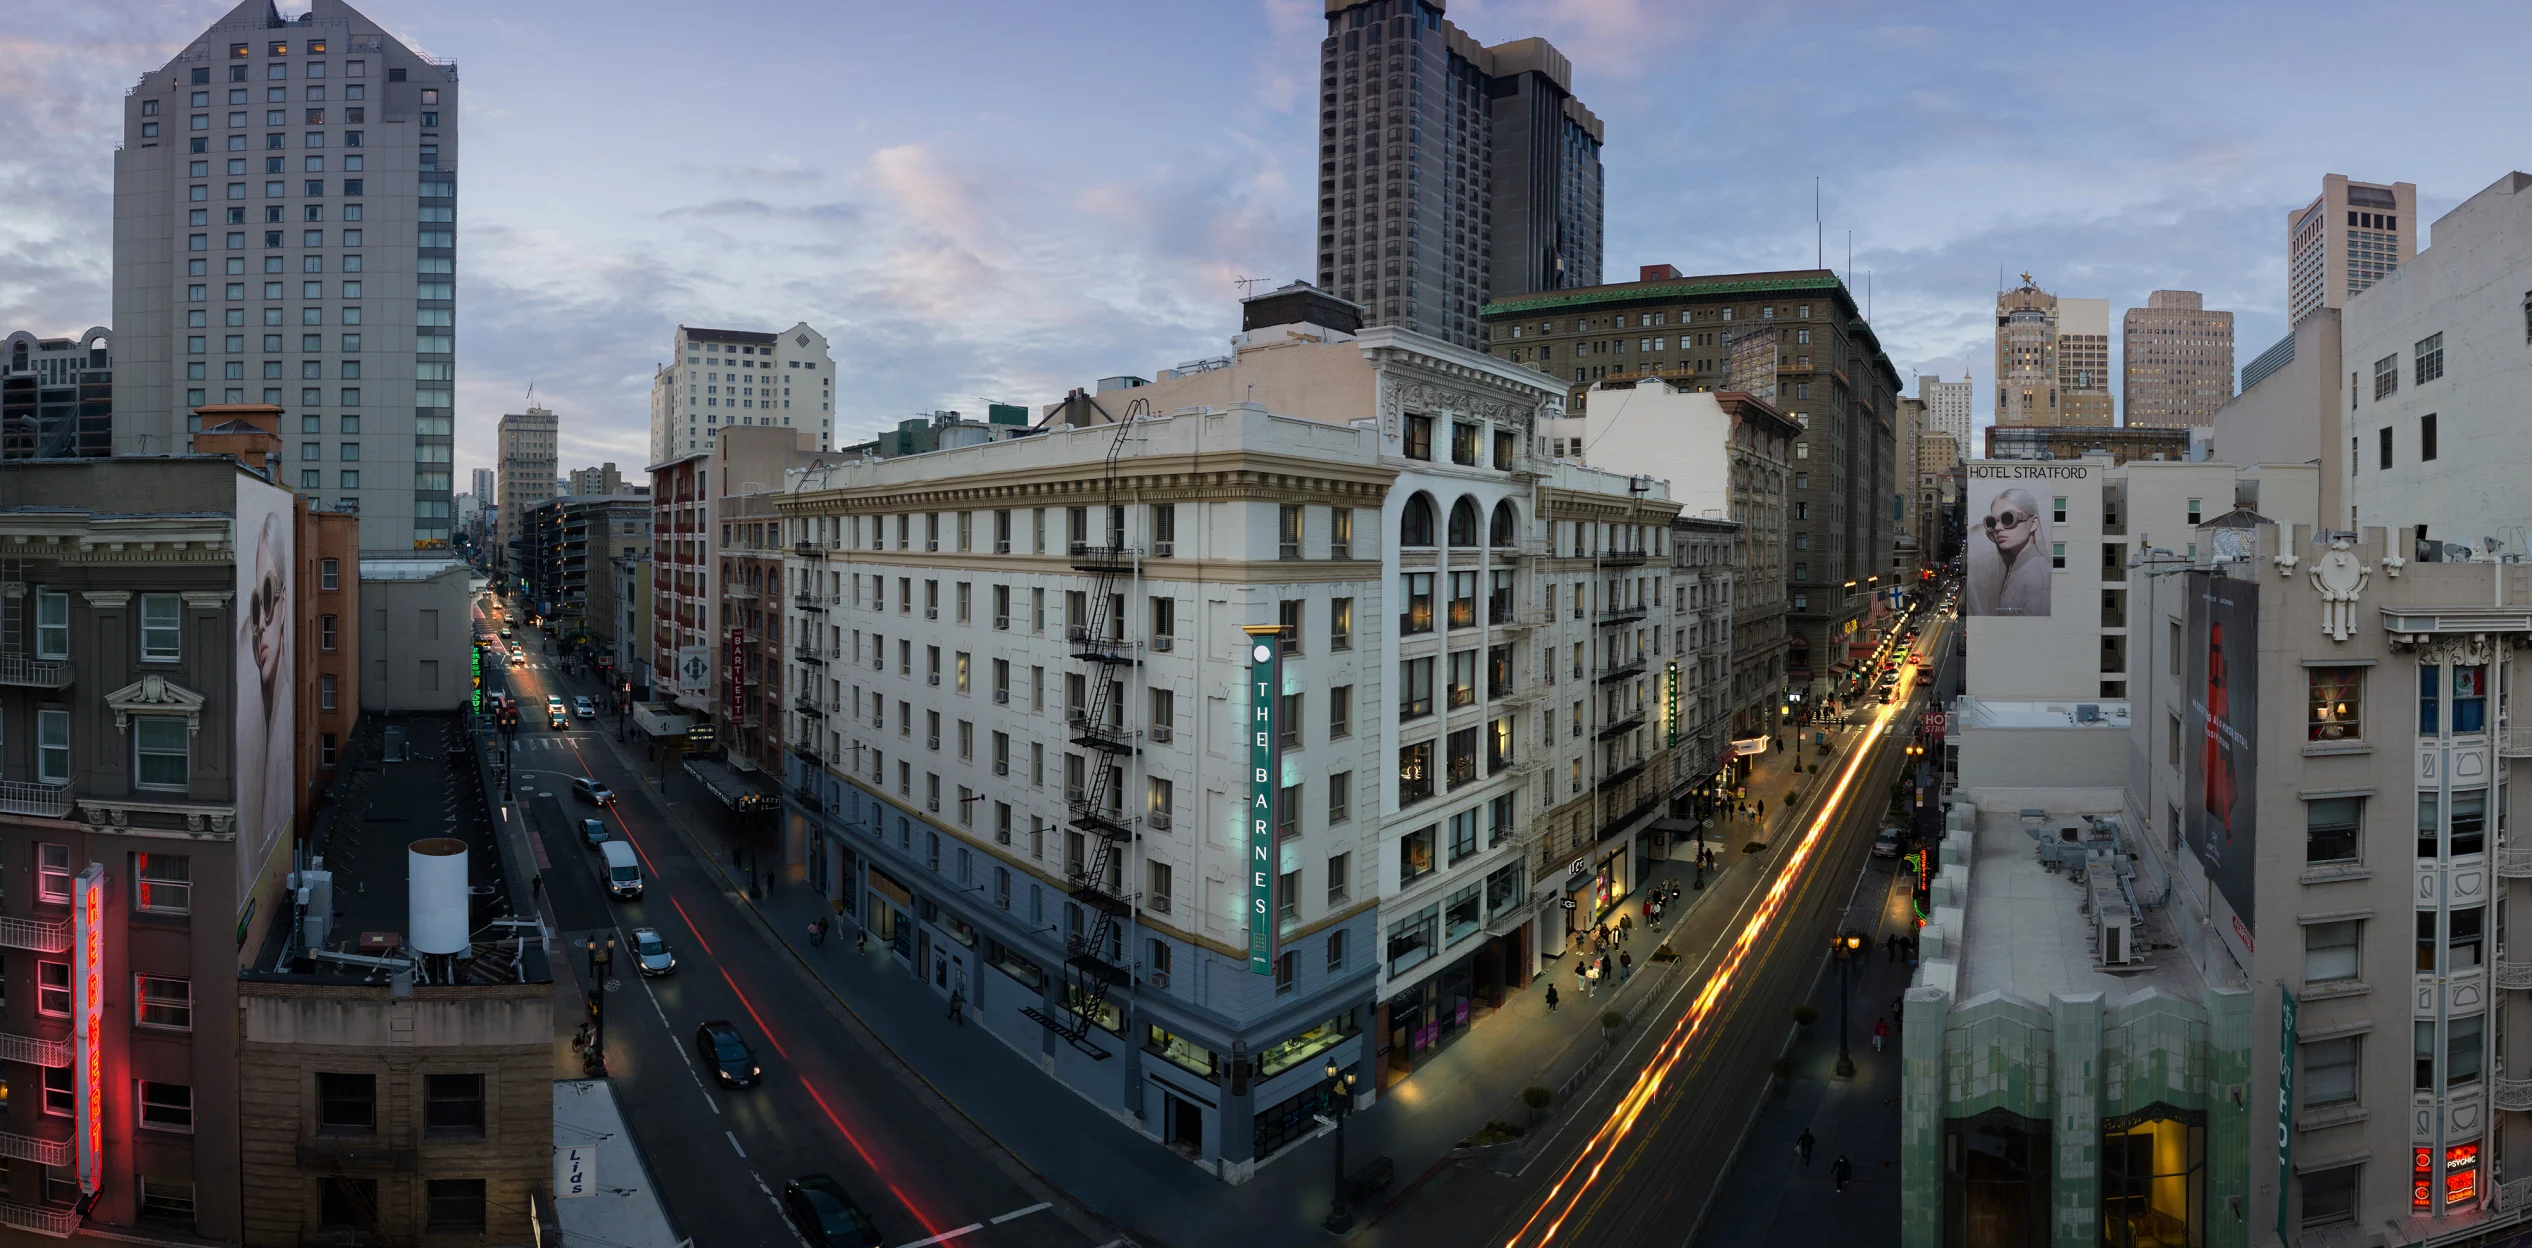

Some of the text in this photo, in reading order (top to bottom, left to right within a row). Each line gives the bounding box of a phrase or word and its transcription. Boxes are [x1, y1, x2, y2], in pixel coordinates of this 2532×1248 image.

[1969, 466, 2087, 479] HOTEL STRATFORD
[734, 636, 743, 714] BARTLETT
[1255, 682, 1268, 914] THE BARNES
[1568, 857, 1584, 875] UGG
[1561, 899, 1576, 909] UGG
[87, 886, 100, 1152] HERBERT
[569, 1149, 583, 1193] Lids
[2447, 1155, 2476, 1168] PSYCHIC
